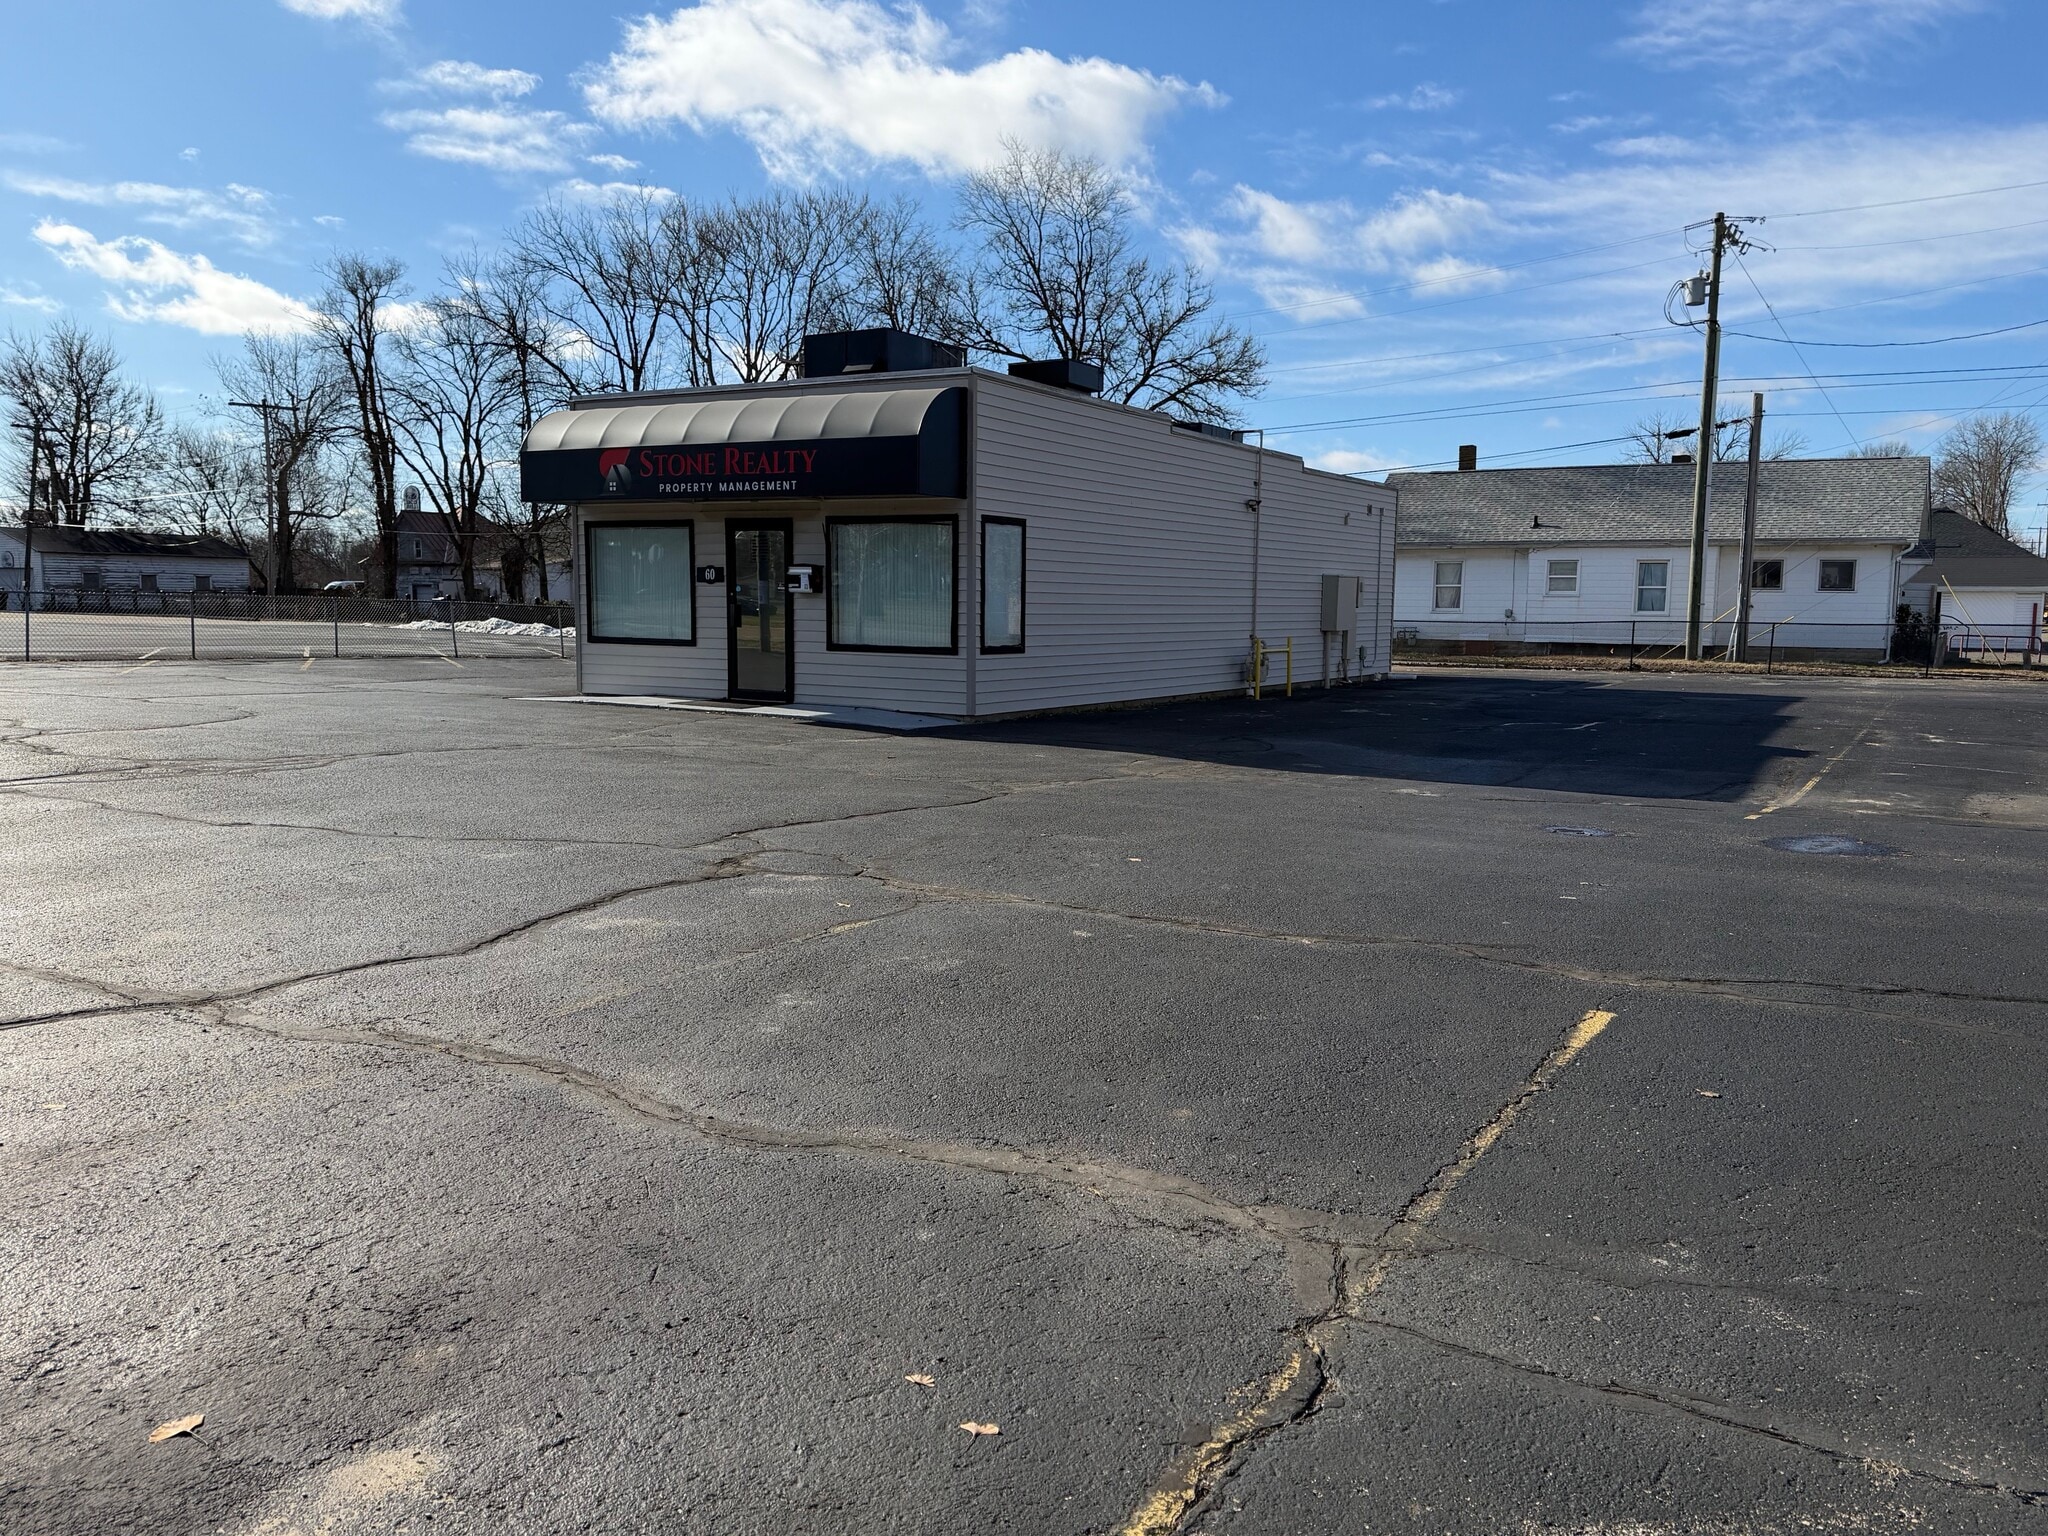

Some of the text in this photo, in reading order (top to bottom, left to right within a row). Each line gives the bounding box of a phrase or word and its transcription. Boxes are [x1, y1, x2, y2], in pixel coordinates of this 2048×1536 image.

[639, 447, 818, 477] STONE REALTY
[659, 480, 797, 493] PROPERTY MANAGEMENT
[705, 568, 715, 580] 60
